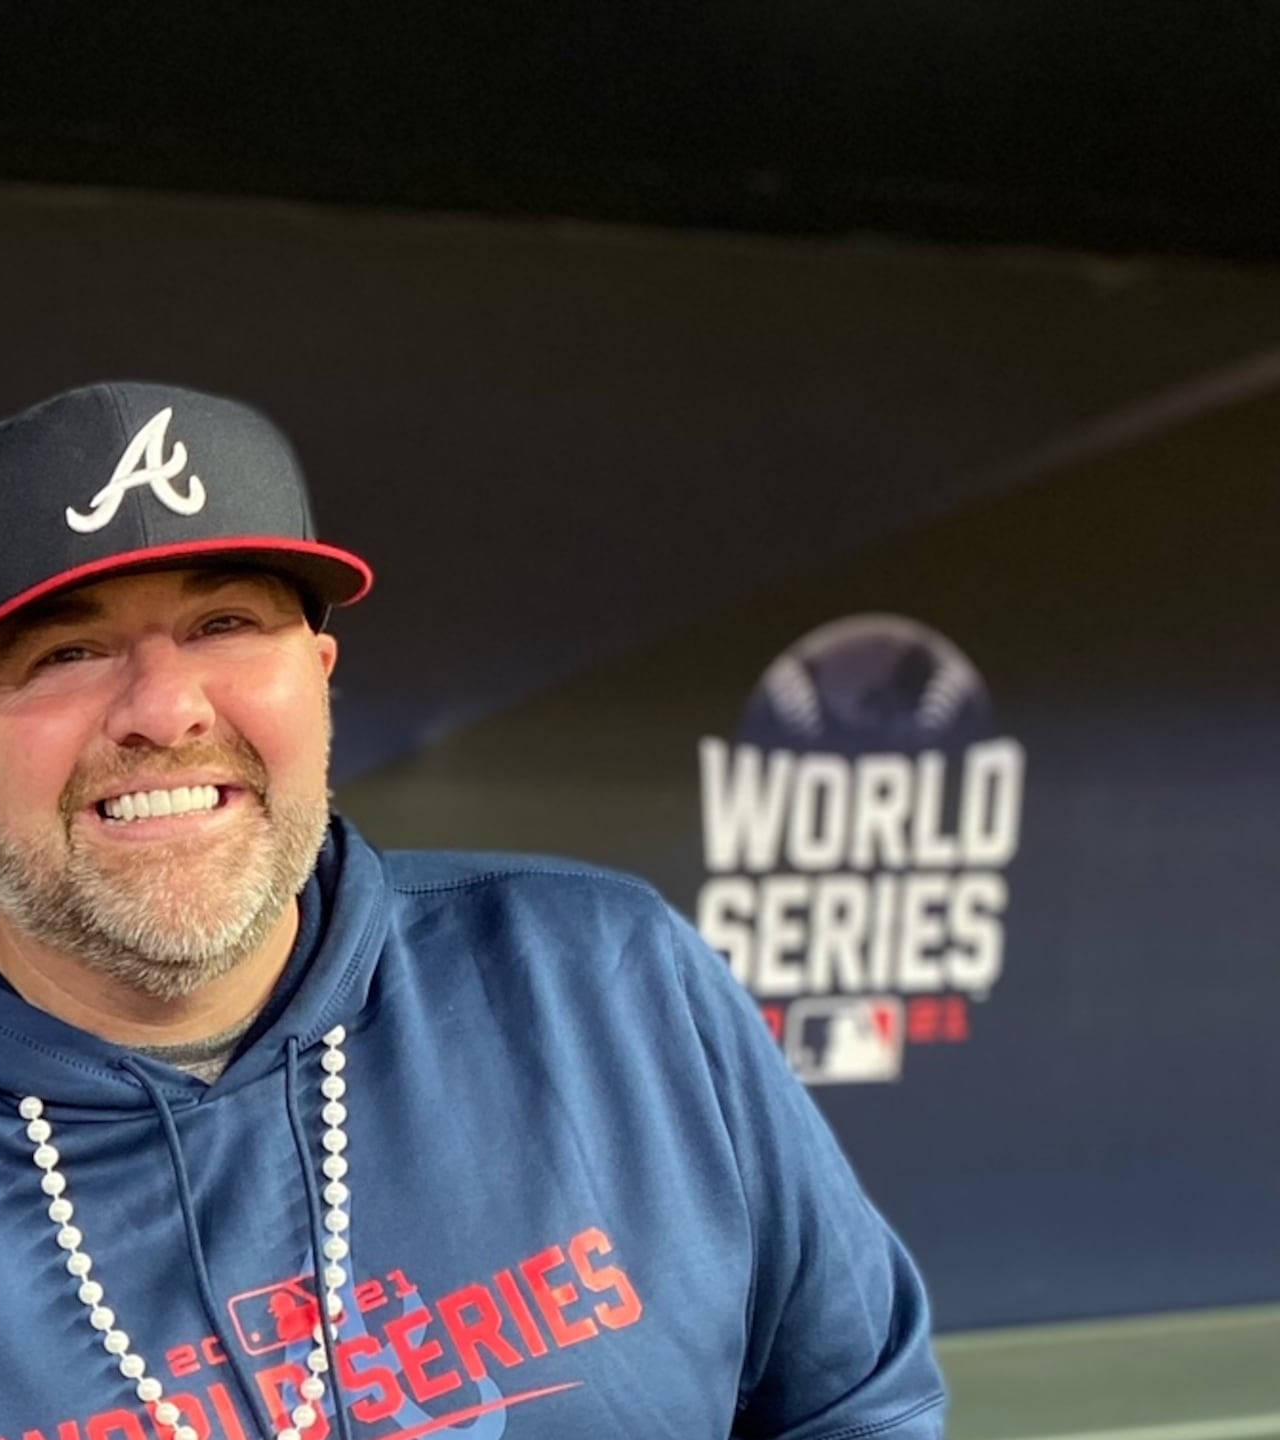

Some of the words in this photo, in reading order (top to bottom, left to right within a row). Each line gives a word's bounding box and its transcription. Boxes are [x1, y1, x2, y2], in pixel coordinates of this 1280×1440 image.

[65, 406, 207, 534] A
[699, 737, 1023, 872] WORLD
[696, 872, 1008, 997] SERIES
[334, 1226, 643, 1423] SERIES
[354, 1268, 418, 1314] 21
